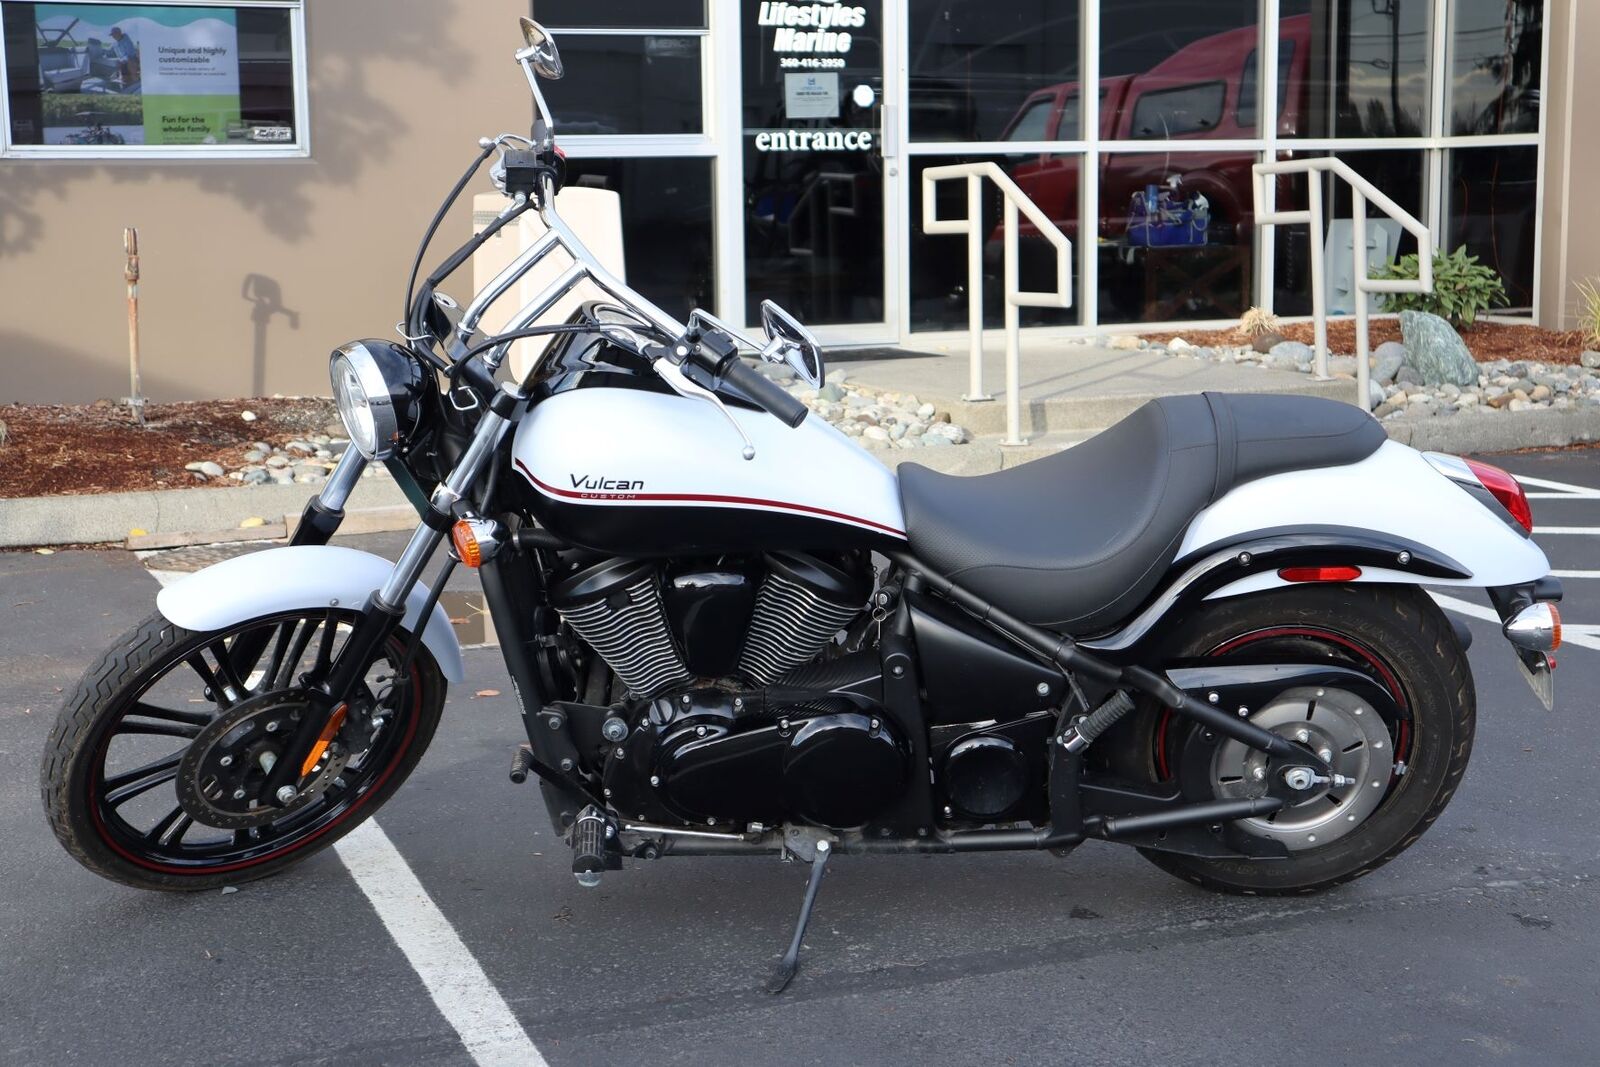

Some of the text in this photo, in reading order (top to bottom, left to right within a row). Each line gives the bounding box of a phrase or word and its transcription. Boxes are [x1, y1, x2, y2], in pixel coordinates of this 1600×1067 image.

[758, 2, 866, 28] Lifestyles
[773, 28, 851, 53] Marine
[158, 47, 186, 56] Unique
[203, 47, 227, 56] highly
[780, 58, 845, 68] 360-416-3950
[755, 130, 872, 151] entrance
[570, 473, 644, 490] Vulcan
